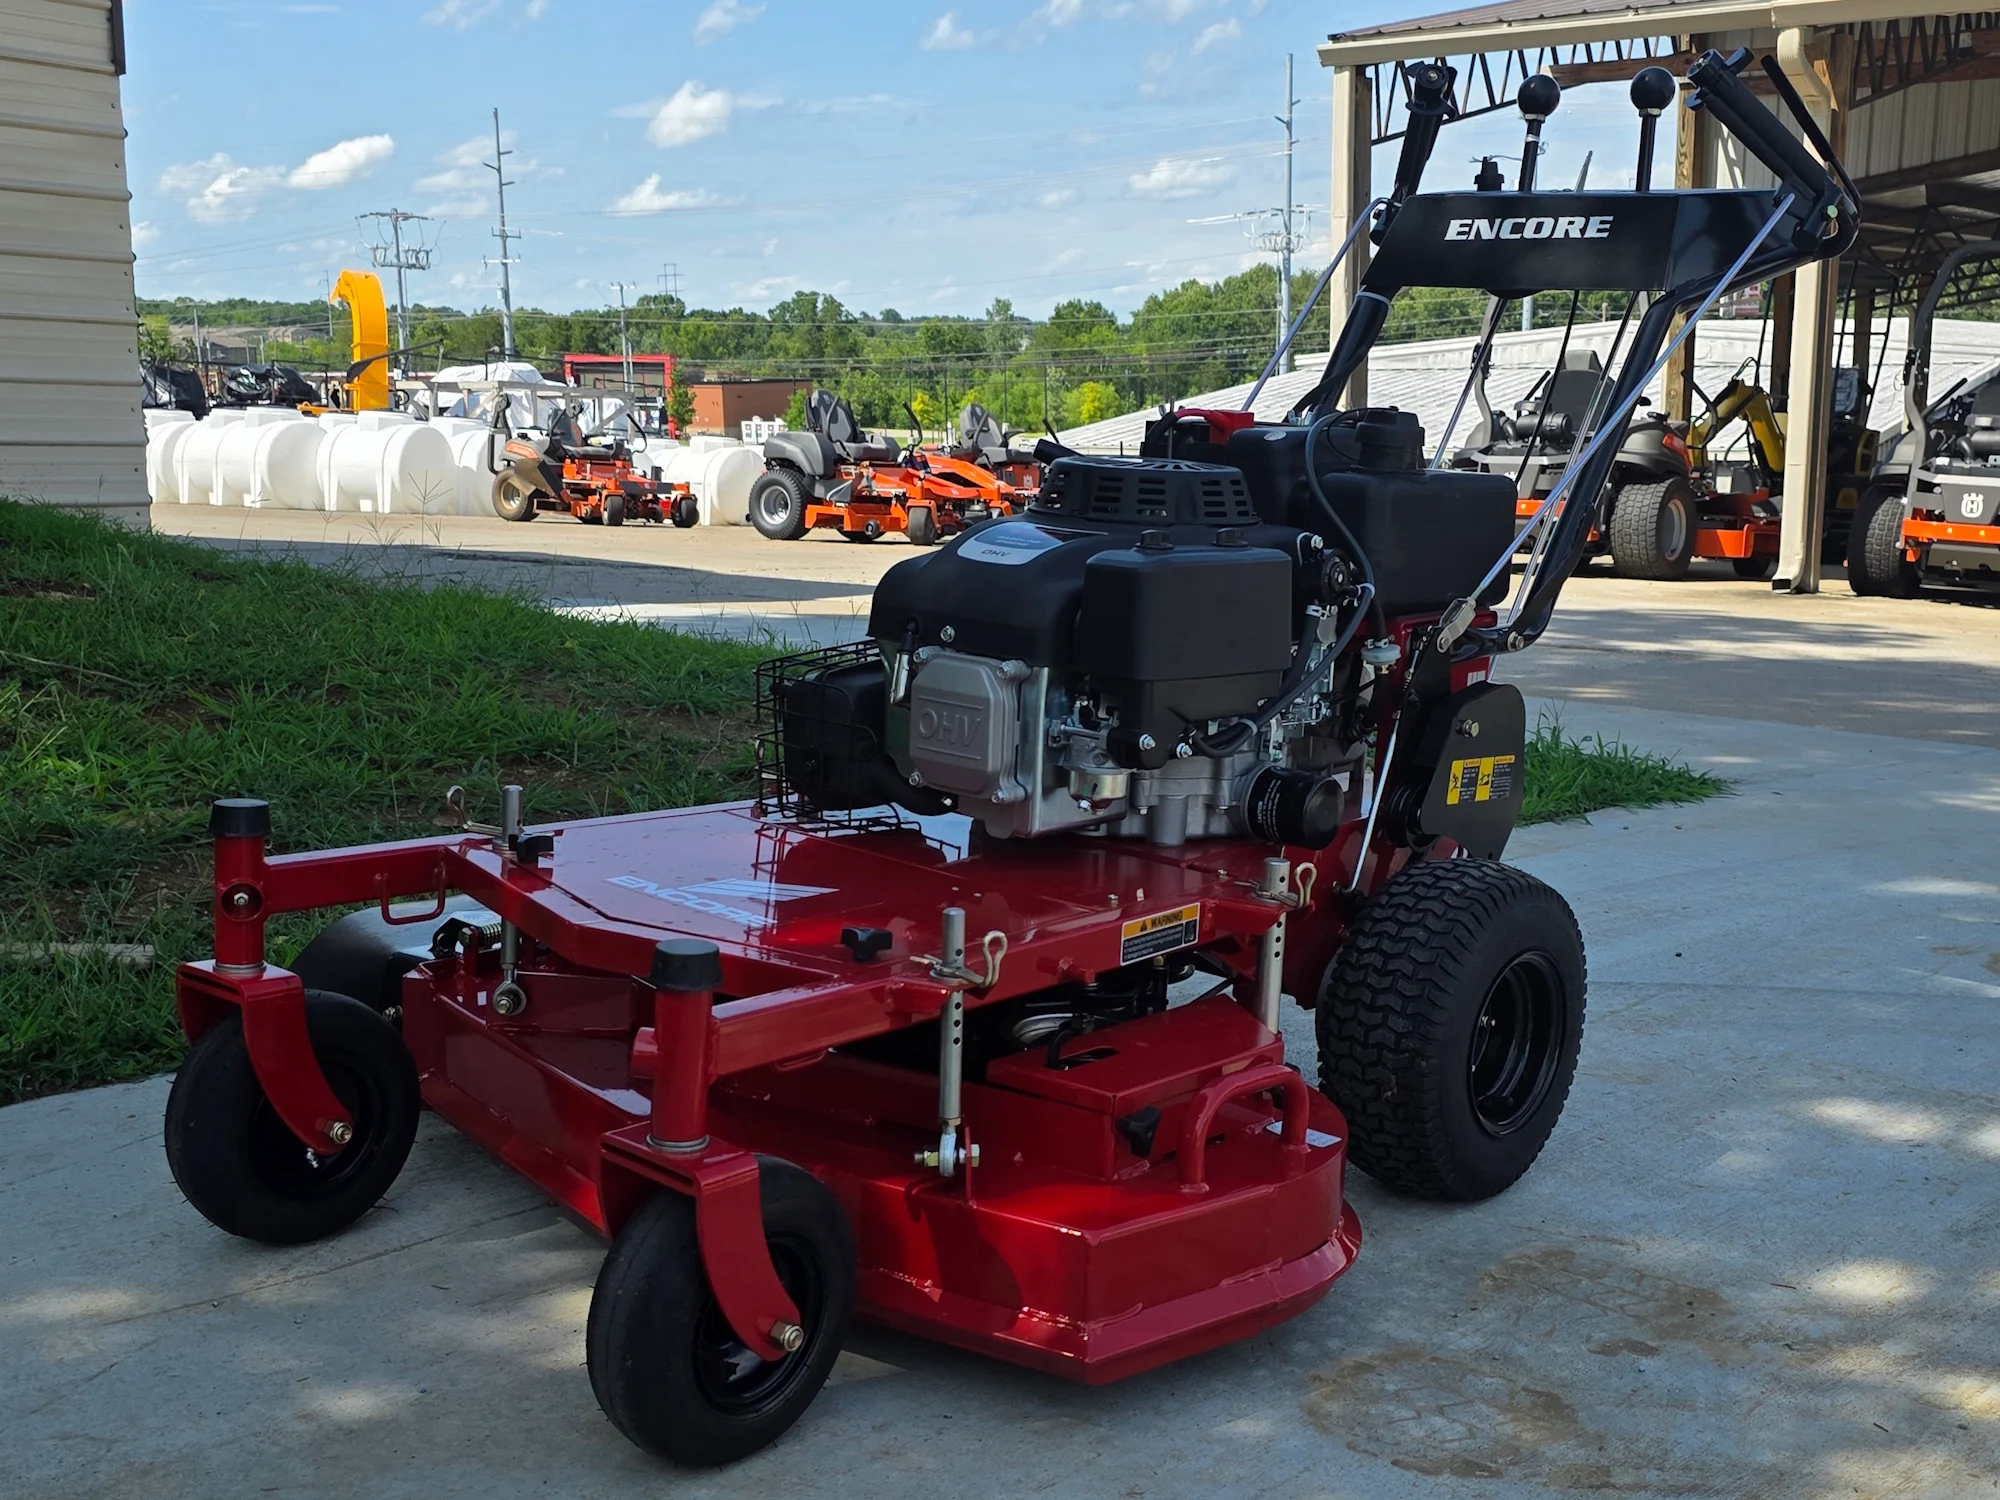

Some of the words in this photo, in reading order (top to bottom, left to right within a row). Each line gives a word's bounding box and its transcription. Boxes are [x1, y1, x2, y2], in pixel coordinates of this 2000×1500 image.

[1444, 216, 1614, 241] ENCORE
[919, 708, 981, 747] OHV
[605, 875, 778, 928] ENCORE
[1150, 910, 1183, 929] WARNING
